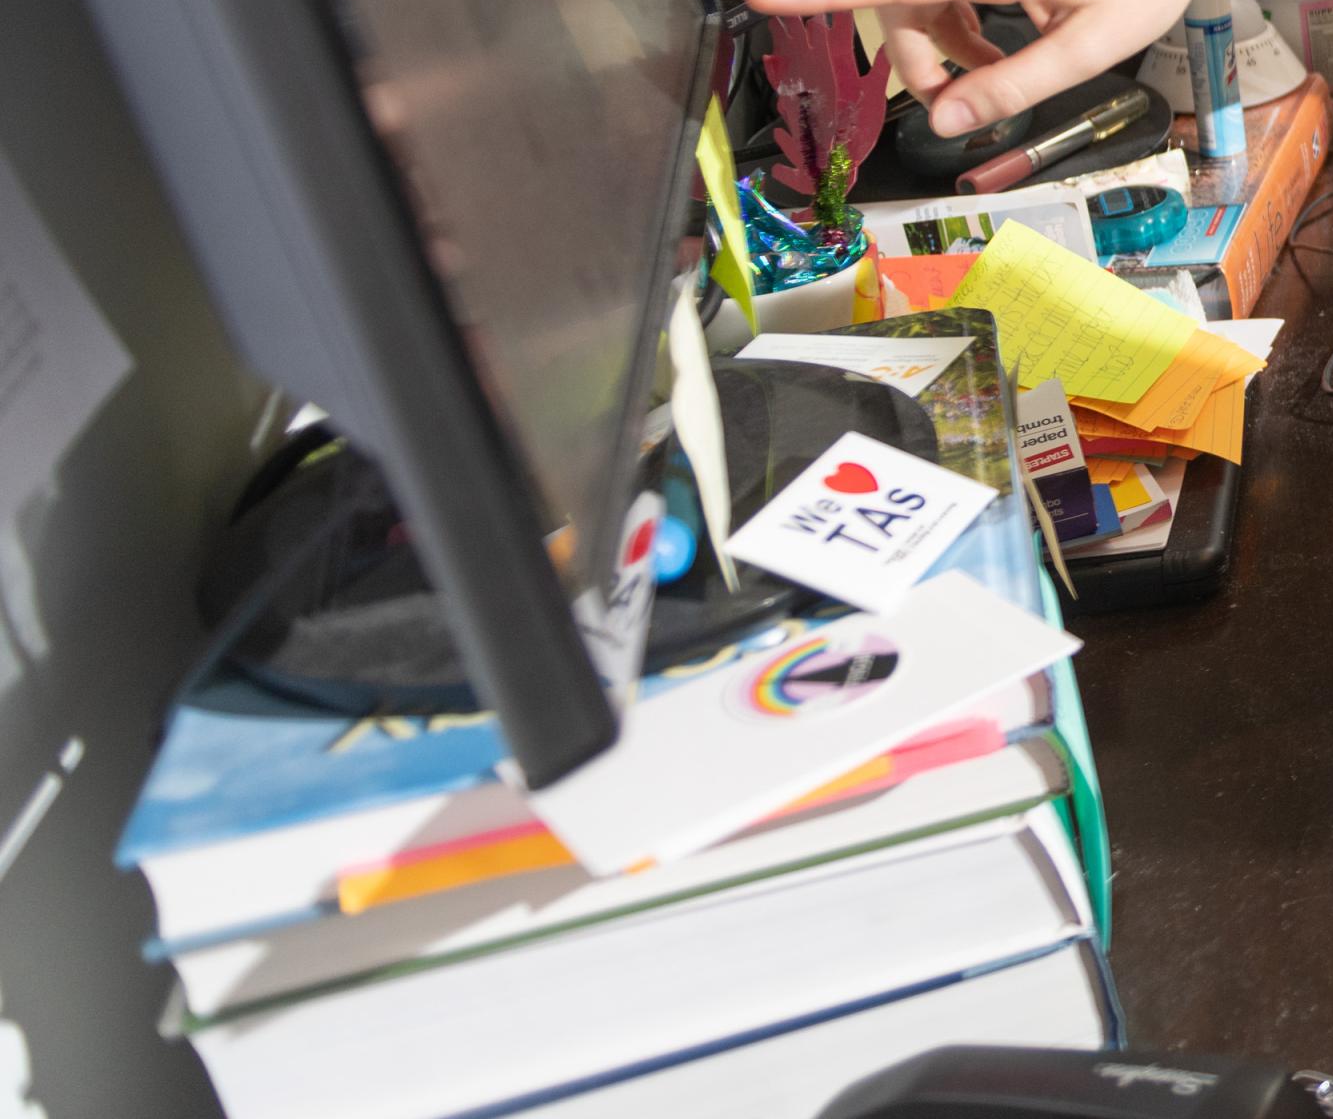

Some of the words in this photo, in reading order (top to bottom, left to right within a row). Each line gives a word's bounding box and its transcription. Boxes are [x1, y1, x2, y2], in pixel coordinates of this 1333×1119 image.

[1021, 428, 1068, 449] paper
[1026, 449, 1070, 469] STAPLES
[781, 499, 843, 534] We
